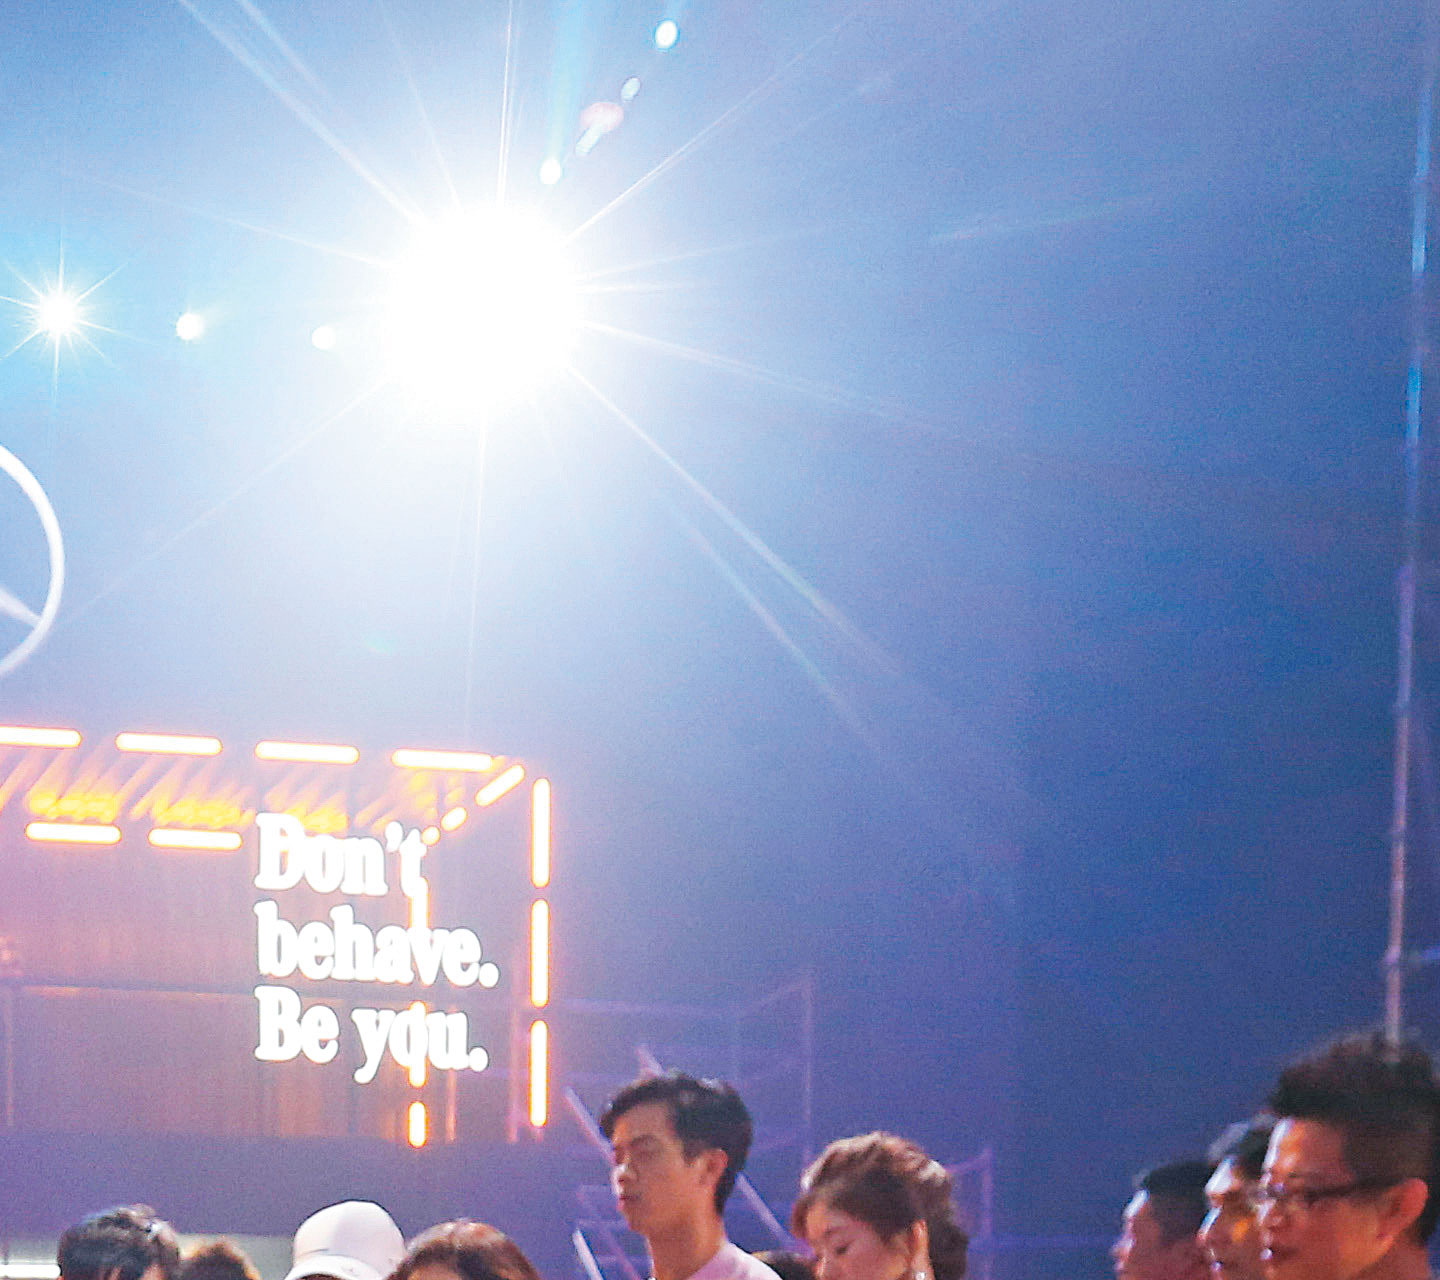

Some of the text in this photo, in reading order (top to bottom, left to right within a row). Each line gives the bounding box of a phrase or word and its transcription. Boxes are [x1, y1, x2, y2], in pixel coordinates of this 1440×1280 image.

[253, 811, 429, 896] Don't
[253, 898, 501, 989] behave.
[253, 984, 490, 1085] Be you.
